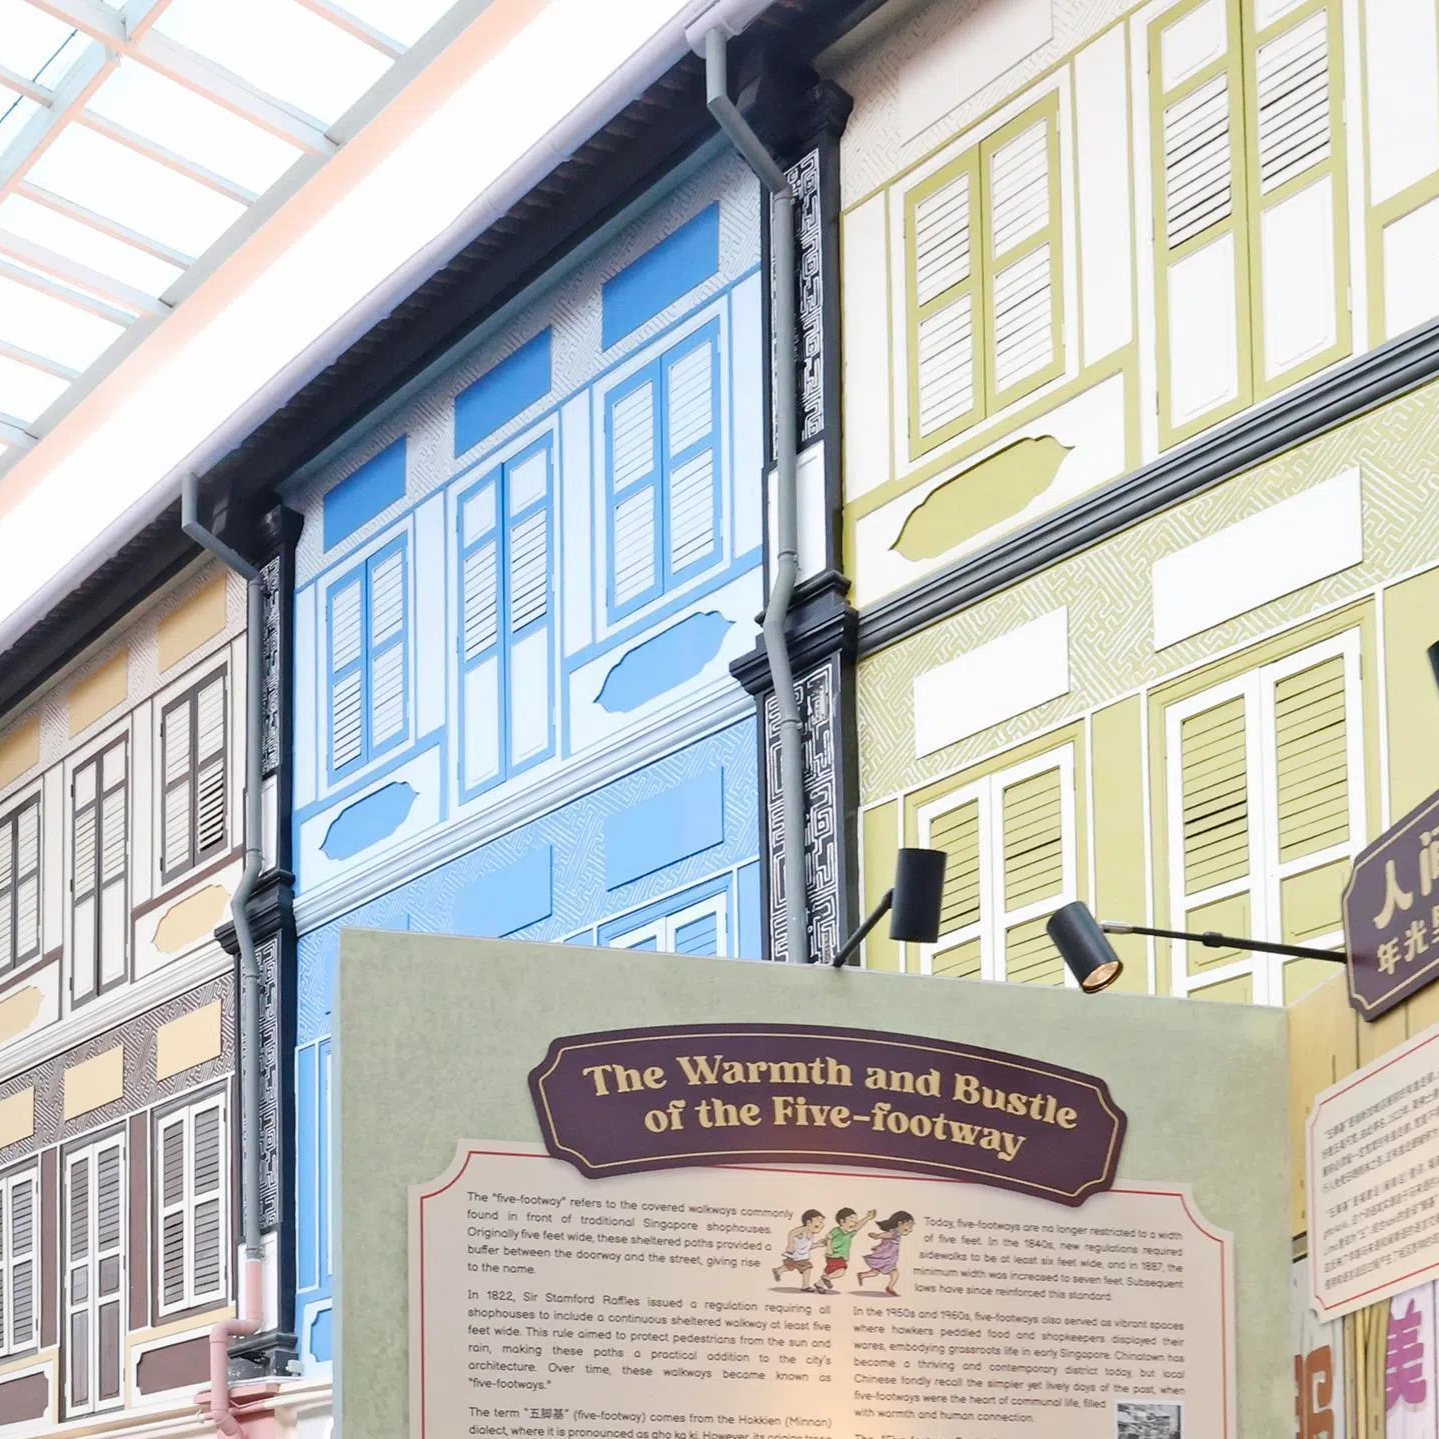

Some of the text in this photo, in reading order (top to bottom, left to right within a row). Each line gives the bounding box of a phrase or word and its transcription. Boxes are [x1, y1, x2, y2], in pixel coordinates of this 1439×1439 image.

[583, 1055, 1079, 1130] The Warmth and Bustle
[644, 1096, 1027, 1161] of the Five-footway
[467, 1191, 489, 1202] The
[569, 1196, 602, 1208] refers
[604, 1199, 617, 1209] to
[619, 1199, 638, 1210] the
[640, 1202, 685, 1212] covered
[687, 1203, 737, 1217] walkways
[739, 1207, 795, 1220] commonly
[466, 1208, 499, 1220] found
[525, 1211, 553, 1223] front
[560, 1213, 572, 1224] of
[579, 1214, 635, 1227] traditional
[642, 1217, 699, 1232] Singapore
[466, 1226, 520, 1241] Originally
[520, 1228, 541, 1239] five
[542, 1229, 565, 1241] feet
[596, 1233, 628, 1244] these
[630, 1234, 682, 1246] sheltered
[683, 1237, 714, 1249] paths
[715, 1239, 762, 1251] provided
[763, 1243, 772, 1251] a
[466, 1243, 500, 1255] buffer
[502, 1246, 551, 1257] between
[553, 1248, 573, 1258] the
[575, 1250, 622, 1262] doorway
[623, 1252, 645, 1262] and
[647, 1252, 666, 1263] the
[705, 1257, 738, 1268] giving
[740, 1258, 761, 1267] rise
[466, 1262, 479, 1271] to
[480, 1262, 500, 1272] the
[466, 1289, 479, 1299] In
[522, 1291, 538, 1302] Sir
[544, 1292, 595, 1304] Stamford
[601, 1294, 640, 1306] Raffles
[646, 1297, 683, 1308] issued
[689, 1300, 697, 1308] a
[703, 1300, 758, 1313] regulation
[764, 1304, 812, 1315] requiring
[818, 1304, 831, 1314] all
[466, 1307, 831, 1331] shophouses to include a continuous sheltered walkway at least five
[467, 1324, 490, 1335] feet
[526, 1326, 549, 1337] This
[551, 1327, 574, 1338] rule
[576, 1329, 612, 1339] aimed
[614, 1330, 627, 1340] to
[629, 1331, 669, 1342] protect
[671, 1333, 736, 1344] pedestrians
[738, 1335, 764, 1345] from
[766, 1336, 785, 1346] the
[788, 1338, 808, 1347] sun
[810, 1339, 831, 1348] and
[501, 1343, 542, 1356] making
[551, 1345, 584, 1356] these
[592, 1347, 624, 1358] paths
[632, 1350, 641, 1358] a
[650, 1349, 697, 1360] practical
[705, 1351, 750, 1362] addition
[758, 1354, 770, 1362] to
[778, 1354, 797, 1364] the
[547, 1362, 575, 1373] Over
[621, 1365, 653, 1376] these
[662, 1367, 712, 1379] walkways
[721, 1370, 766, 1379] became
[775, 1372, 809, 1381] known
[818, 1374, 832, 1382] as
[469, 1406, 490, 1417] The
[493, 1408, 520, 1418] term
[572, 1409, 646, 1423] (five-footway)
[648, 1414, 686, 1422] comes
[688, 1413, 714, 1423] from
[716, 1414, 735, 1424] the
[737, 1415, 781, 1425] Hokkien
[784, 1416, 832, 1428] (Minnan)
